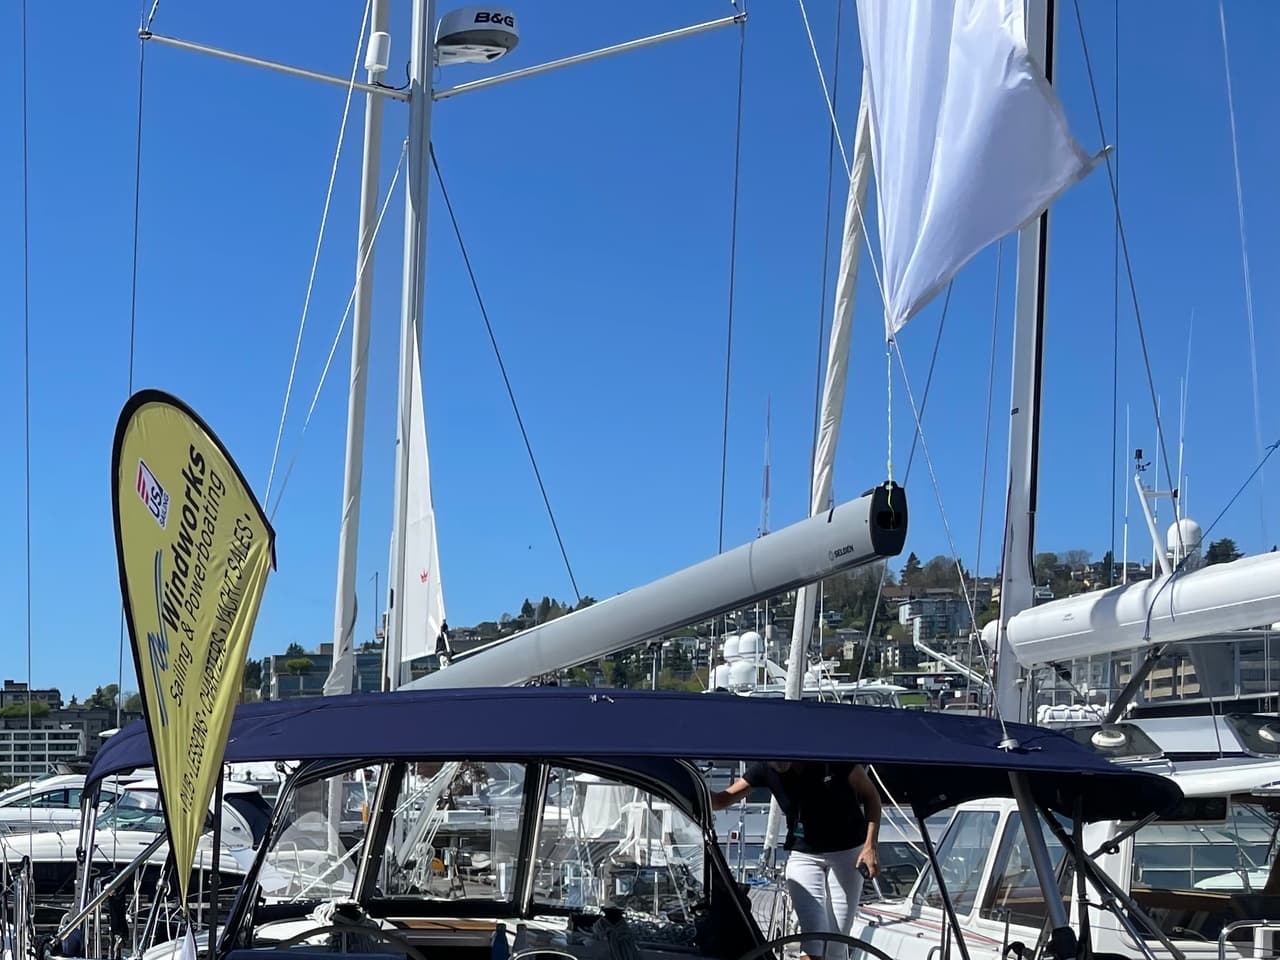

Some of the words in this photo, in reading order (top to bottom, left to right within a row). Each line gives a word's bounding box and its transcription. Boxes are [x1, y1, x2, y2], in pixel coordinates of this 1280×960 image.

[474, 12, 514, 27] B&G
[148, 485, 164, 519] US
[162, 444, 206, 633] Windworks
[184, 469, 226, 622] Powerboating
[227, 517, 254, 580] SALES
[181, 620, 195, 641] &
[216, 569, 241, 630] YACHT
[170, 641, 193, 707] Sailing
[200, 632, 227, 715] CHARTERS
[187, 711, 209, 779] LESSONS
